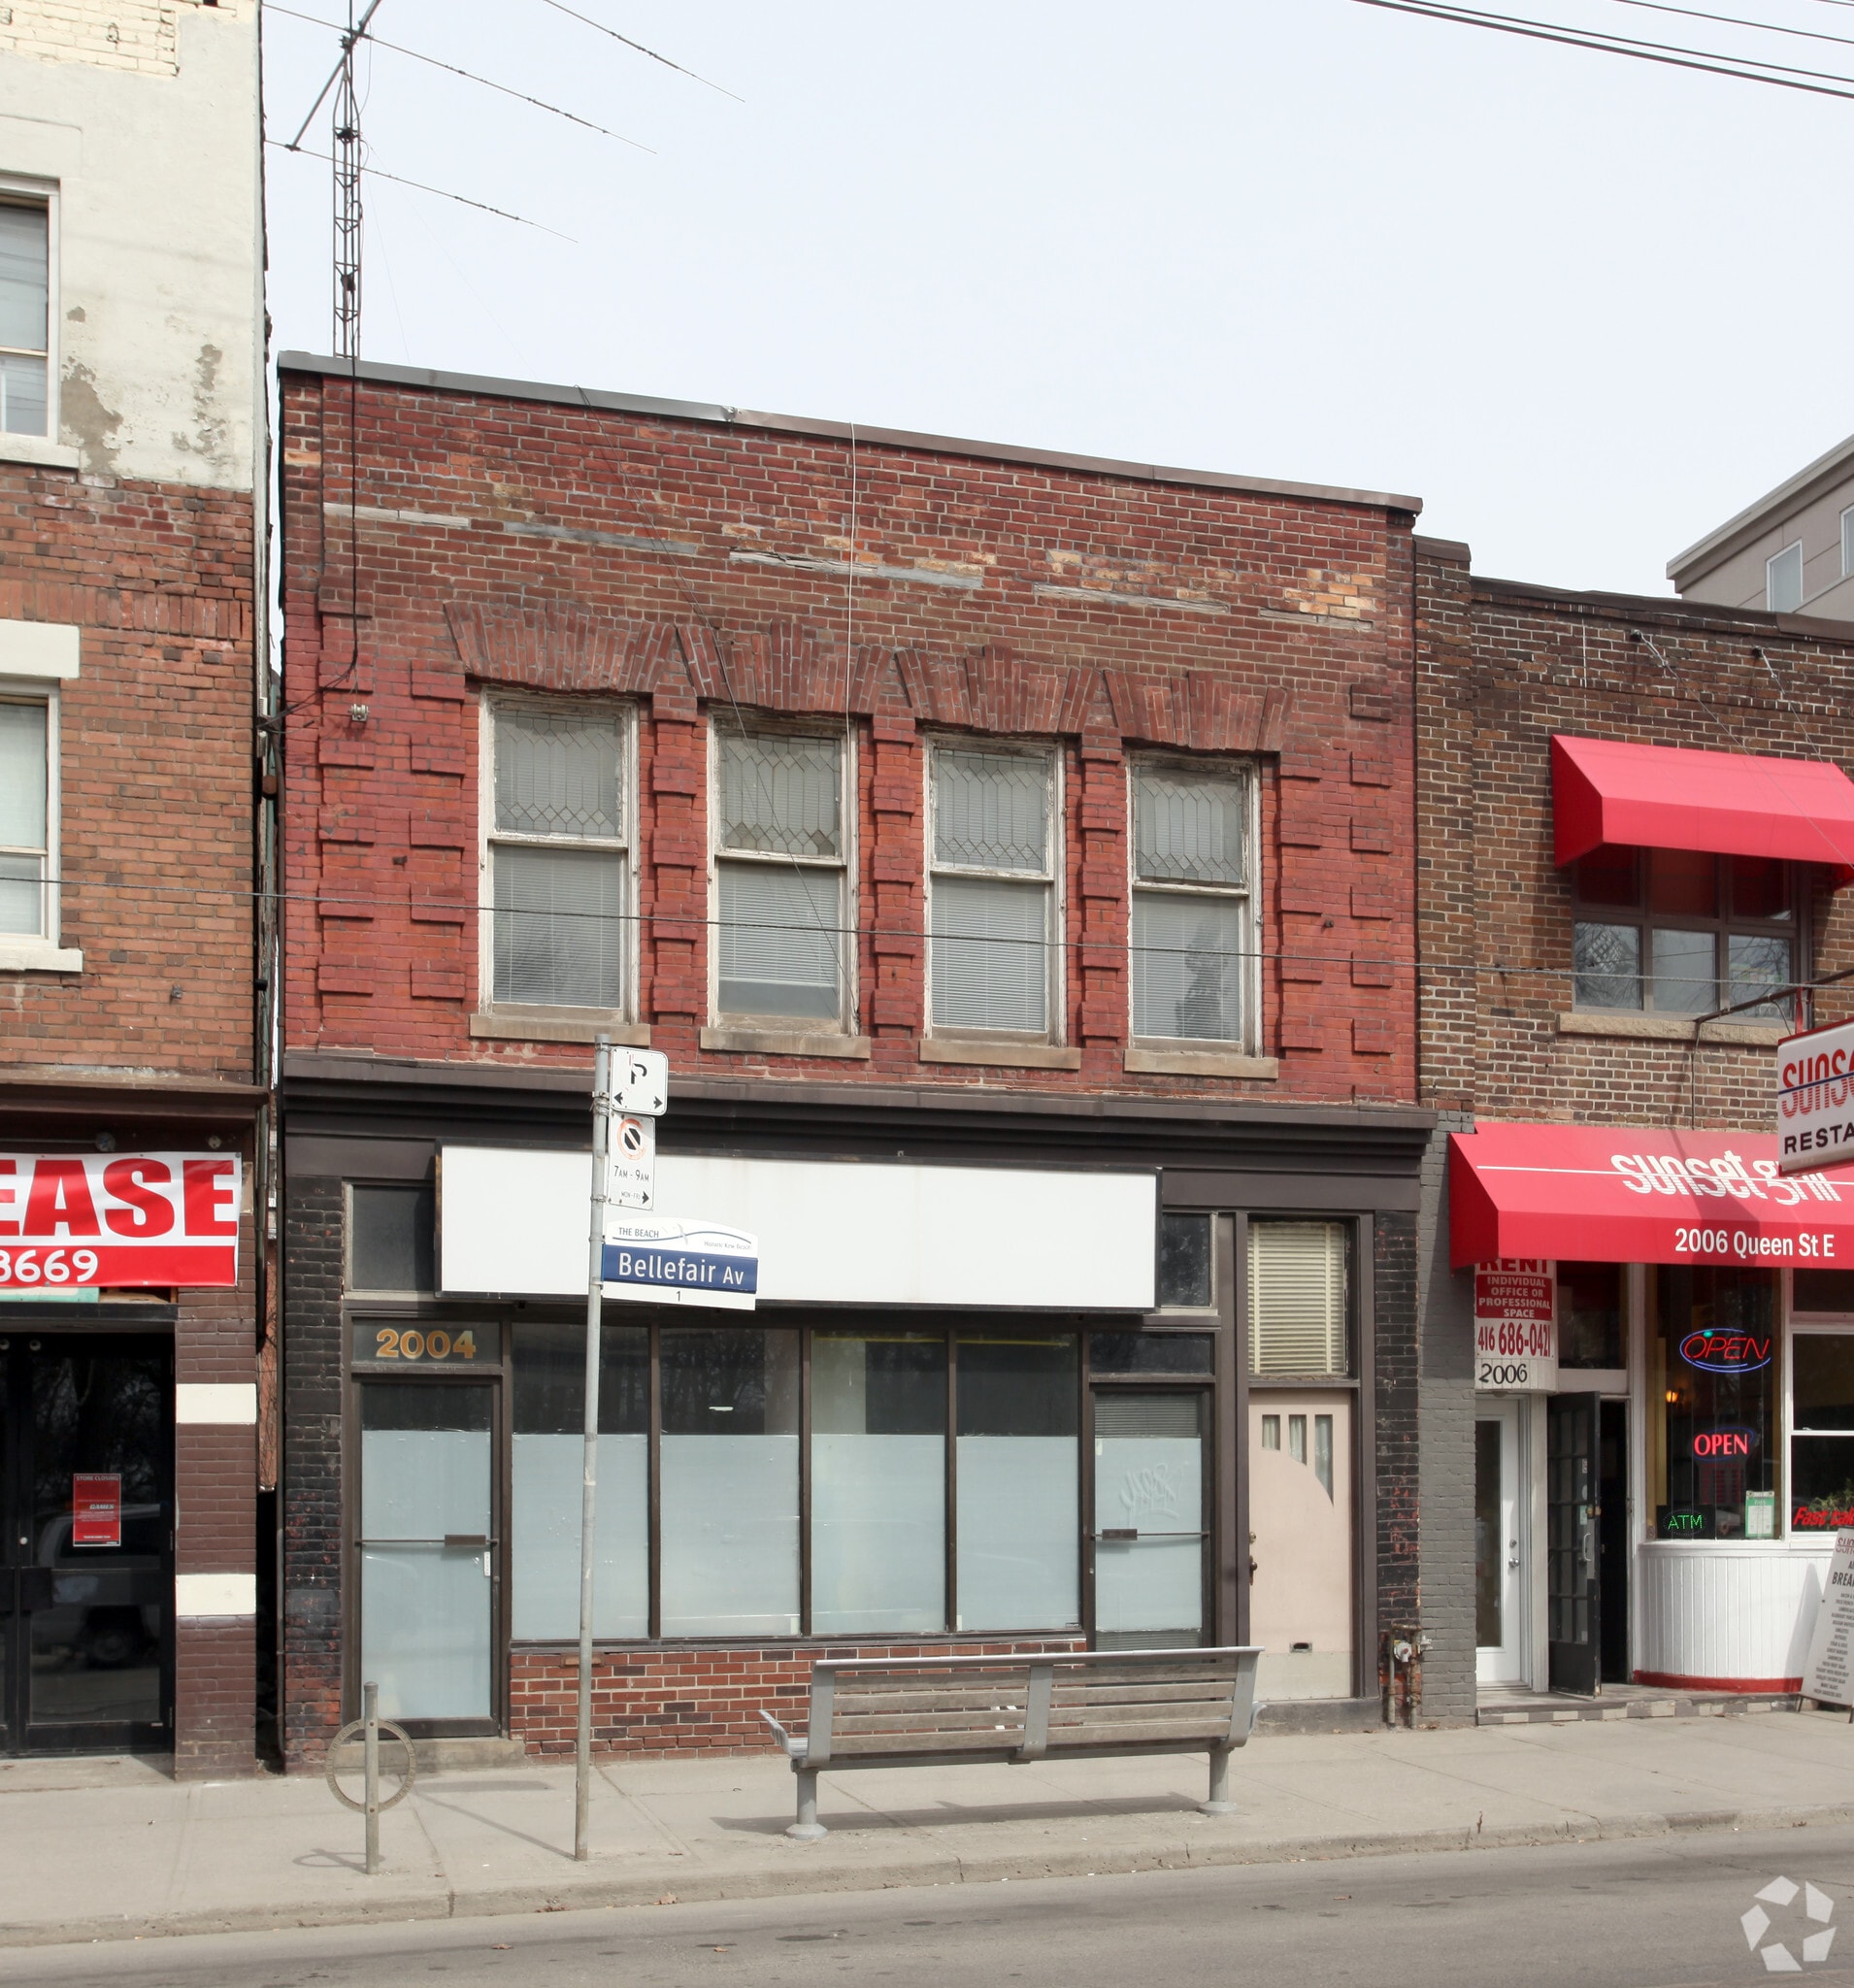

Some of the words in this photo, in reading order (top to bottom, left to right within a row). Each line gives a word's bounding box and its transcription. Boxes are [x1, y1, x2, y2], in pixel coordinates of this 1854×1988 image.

[1784, 1122, 1854, 1154] RESTA
[614, 1165, 628, 1178] 7AM
[635, 1169, 649, 1182] 9AM
[618, 1227, 632, 1237] THE
[635, 1228, 659, 1239] BEACH
[1674, 1228, 1728, 1253] 2006
[1734, 1230, 1793, 1258] Queen
[1799, 1233, 1818, 1256] St
[1823, 1234, 1835, 1257] E
[618, 1252, 716, 1282] Bellefair
[722, 1266, 745, 1284] Av
[1487, 1276, 1545, 1287] INDIVIDUAL
[676, 1290, 681, 1302] 1
[1491, 1287, 1528, 1297] OFFICE
[1532, 1289, 1543, 1298] OR
[1479, 1298, 1550, 1309] PROFESSIONAL
[1504, 1309, 1535, 1318] SPACE
[376, 1329, 477, 1359] 2004
[1478, 1326, 1495, 1351] 416
[1499, 1322, 1551, 1357] 686-0421
[1684, 1337, 1770, 1359] OPEN
[1478, 1363, 1528, 1384] 2006
[1694, 1434, 1748, 1455] OPEN
[1668, 1514, 1703, 1530] ATM
[1793, 1506, 1829, 1526] Fast
[1832, 1572, 1854, 1587] BREA
